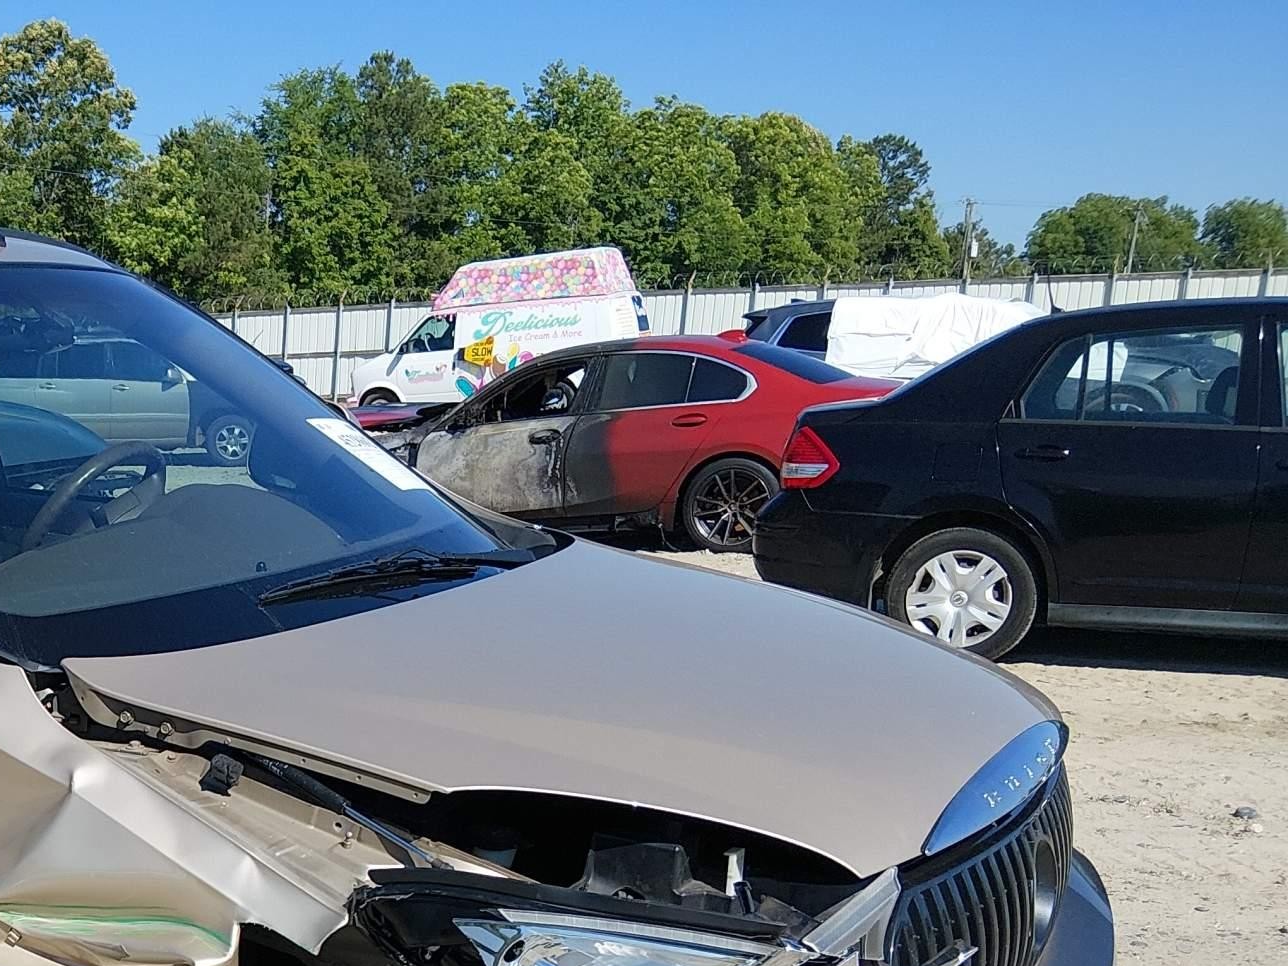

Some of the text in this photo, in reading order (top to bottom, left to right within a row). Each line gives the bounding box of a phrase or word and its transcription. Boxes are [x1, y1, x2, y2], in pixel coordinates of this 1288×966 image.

[473, 311, 582, 339] Deelicious
[508, 334, 524, 343] Ice
[526, 332, 550, 342] Cream
[561, 329, 583, 338] More
[471, 346, 494, 358] SLOW
